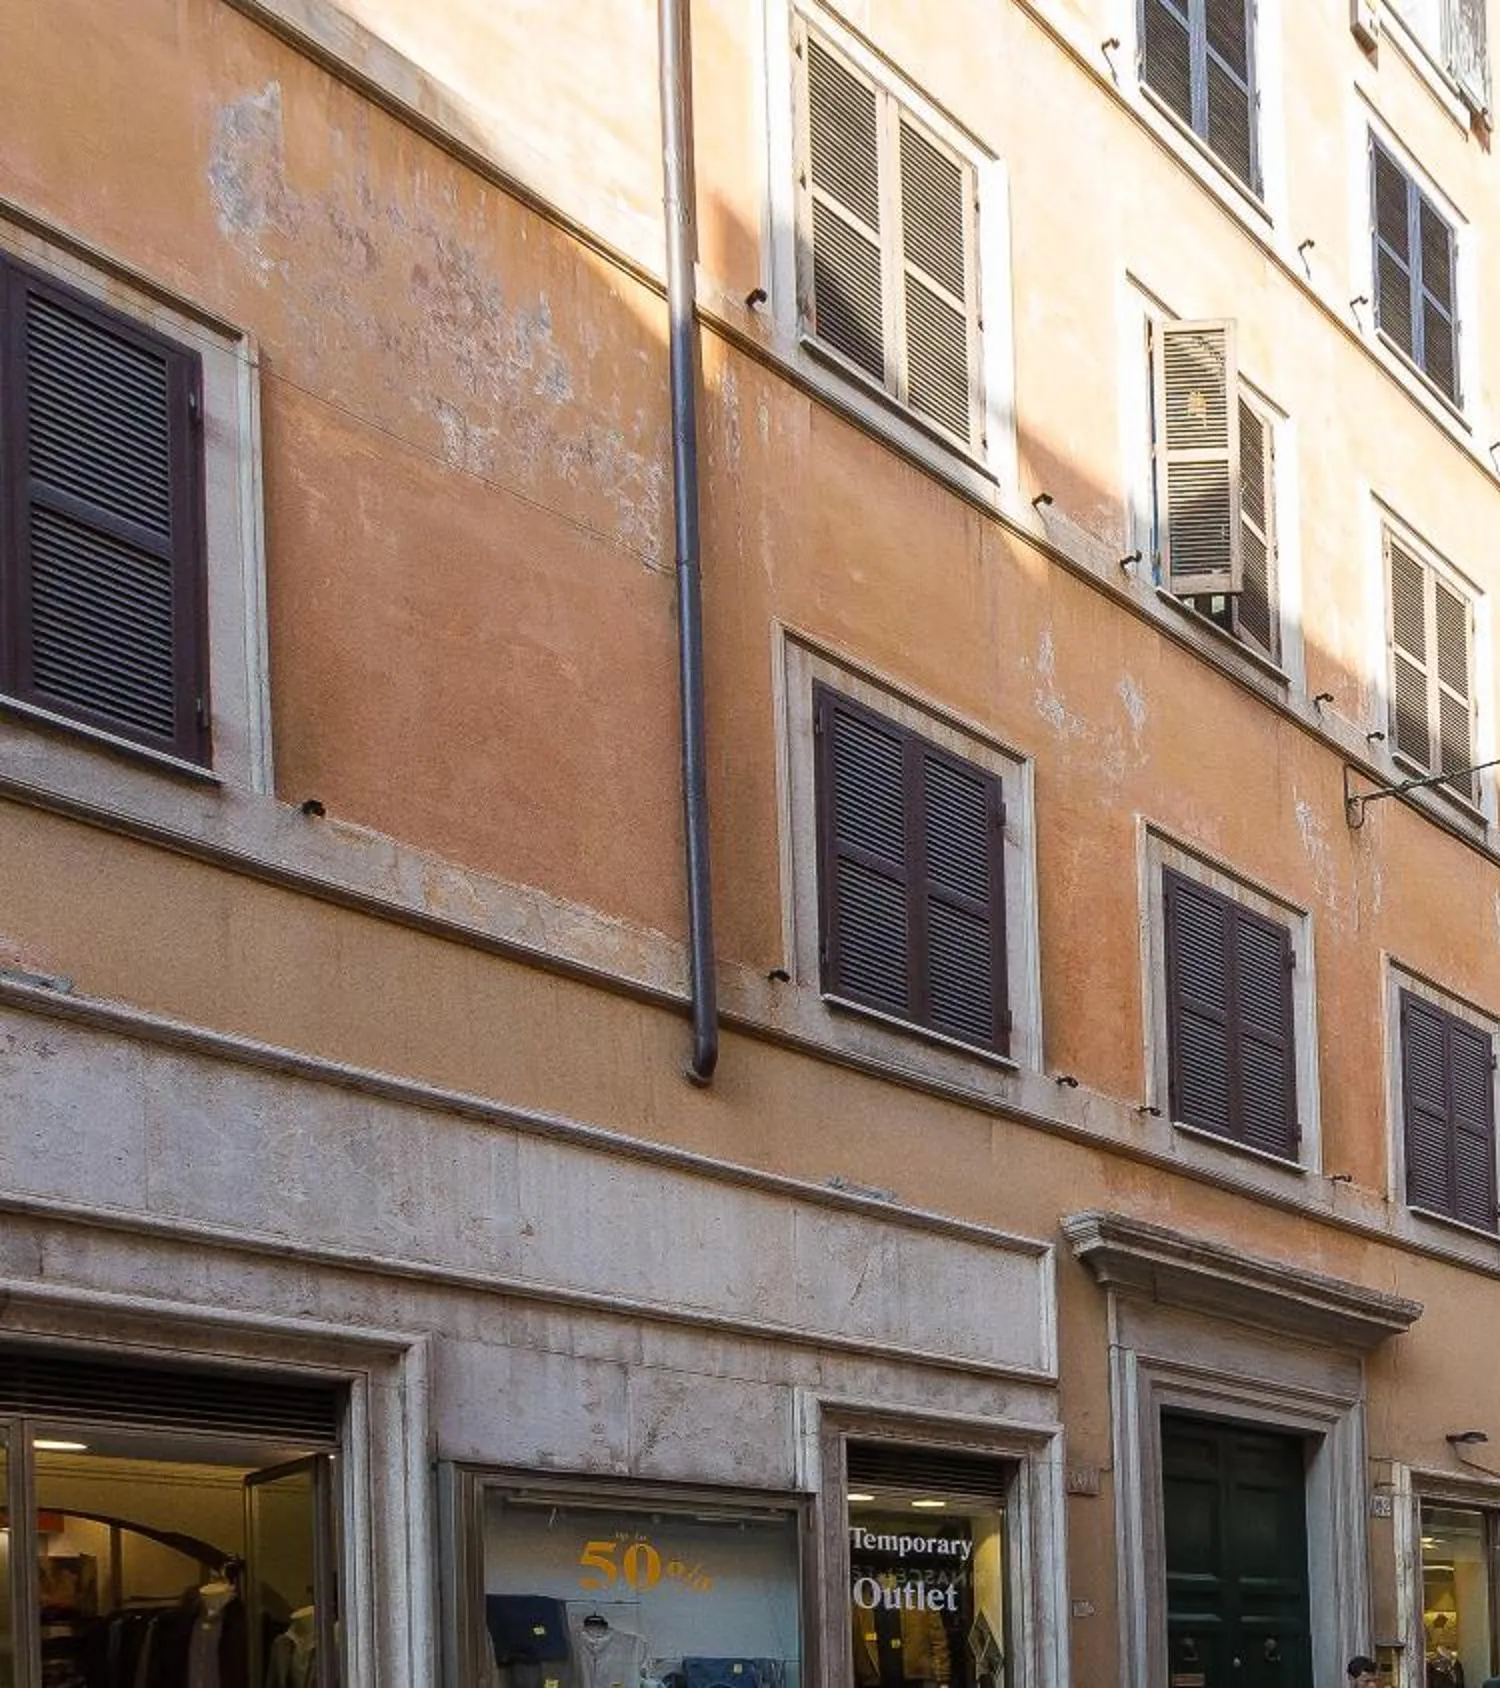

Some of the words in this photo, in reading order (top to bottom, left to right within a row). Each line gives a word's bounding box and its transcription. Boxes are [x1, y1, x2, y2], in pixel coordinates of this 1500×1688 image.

[849, 1527, 973, 1560] Temporary
[577, 1540, 714, 1592] 50%
[853, 1577, 958, 1612] Outlet
